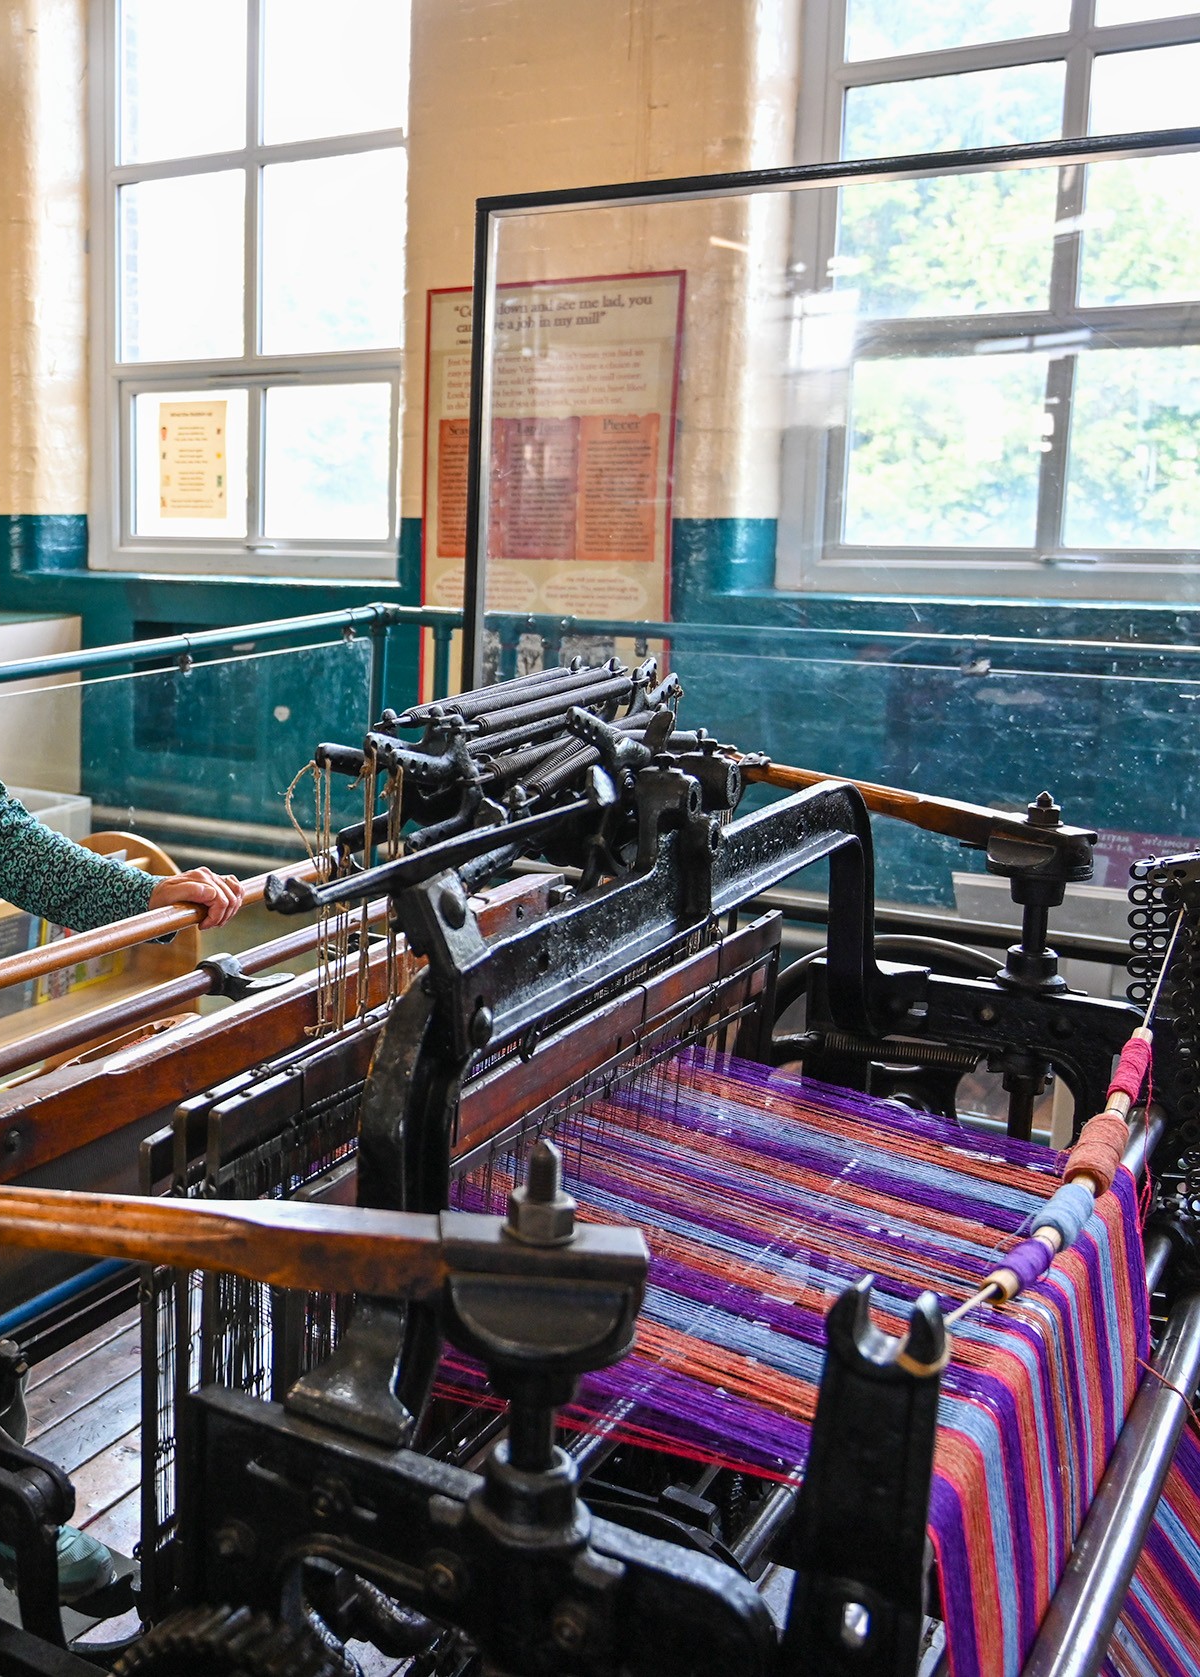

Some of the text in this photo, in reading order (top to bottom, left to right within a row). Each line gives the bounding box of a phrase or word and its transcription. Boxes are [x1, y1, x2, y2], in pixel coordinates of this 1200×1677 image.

[496, 302, 527, 315] down
[531, 300, 553, 312] and
[557, 301, 576, 311] see
[579, 300, 599, 309] me
[602, 294, 625, 308] lad,
[628, 296, 653, 308] you
[516, 316, 535, 331] job
[540, 316, 551, 327] in
[554, 317, 573, 328] my
[603, 418, 641, 431] Piecer
